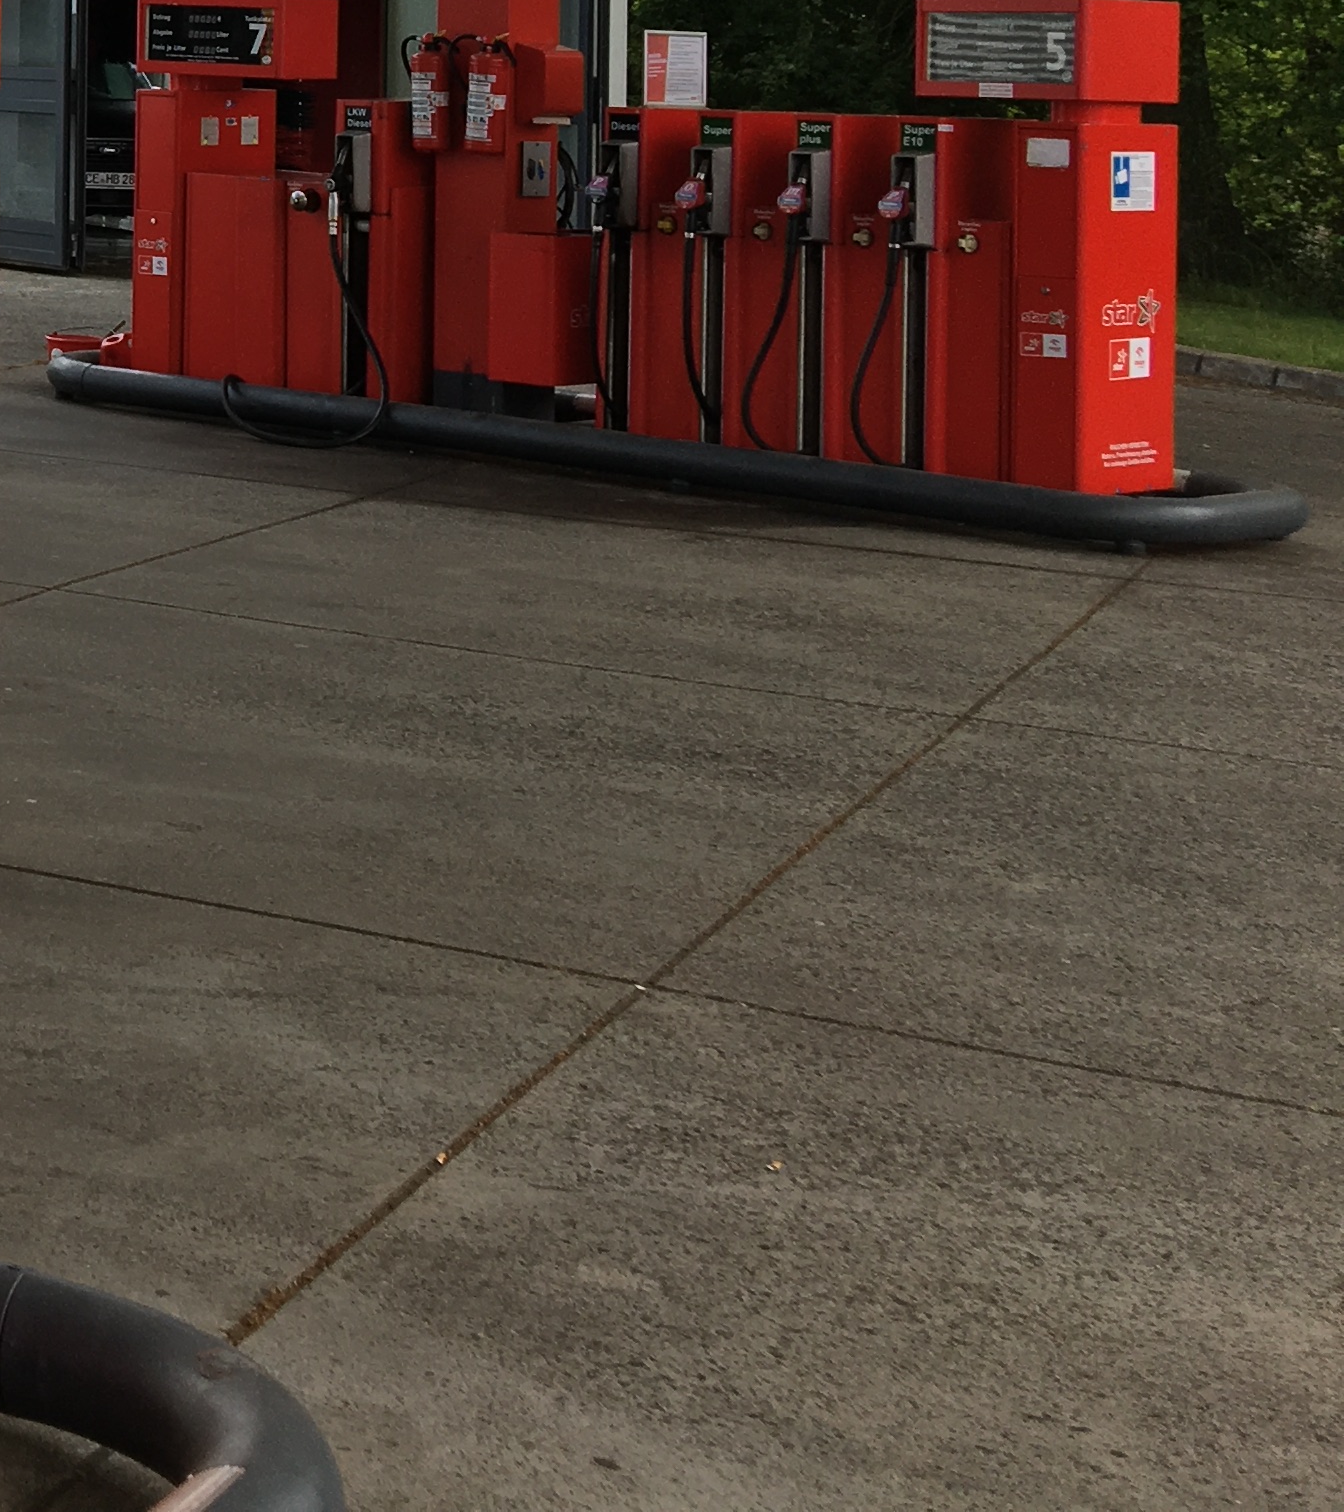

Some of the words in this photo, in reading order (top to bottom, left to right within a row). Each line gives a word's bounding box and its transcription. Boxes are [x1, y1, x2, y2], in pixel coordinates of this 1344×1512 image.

[248, 23, 267, 54] 7
[1046, 32, 1066, 71] 5
[347, 108, 366, 117] LKW
[347, 118, 372, 128] Diesel
[611, 121, 640, 131] Diesel
[800, 122, 832, 134] Super
[703, 124, 733, 136] Super
[904, 124, 935, 136] Super
[799, 135, 822, 146] plus
[903, 136, 924, 147] E10
[1021, 310, 1049, 323] star
[1101, 299, 1137, 327] star
